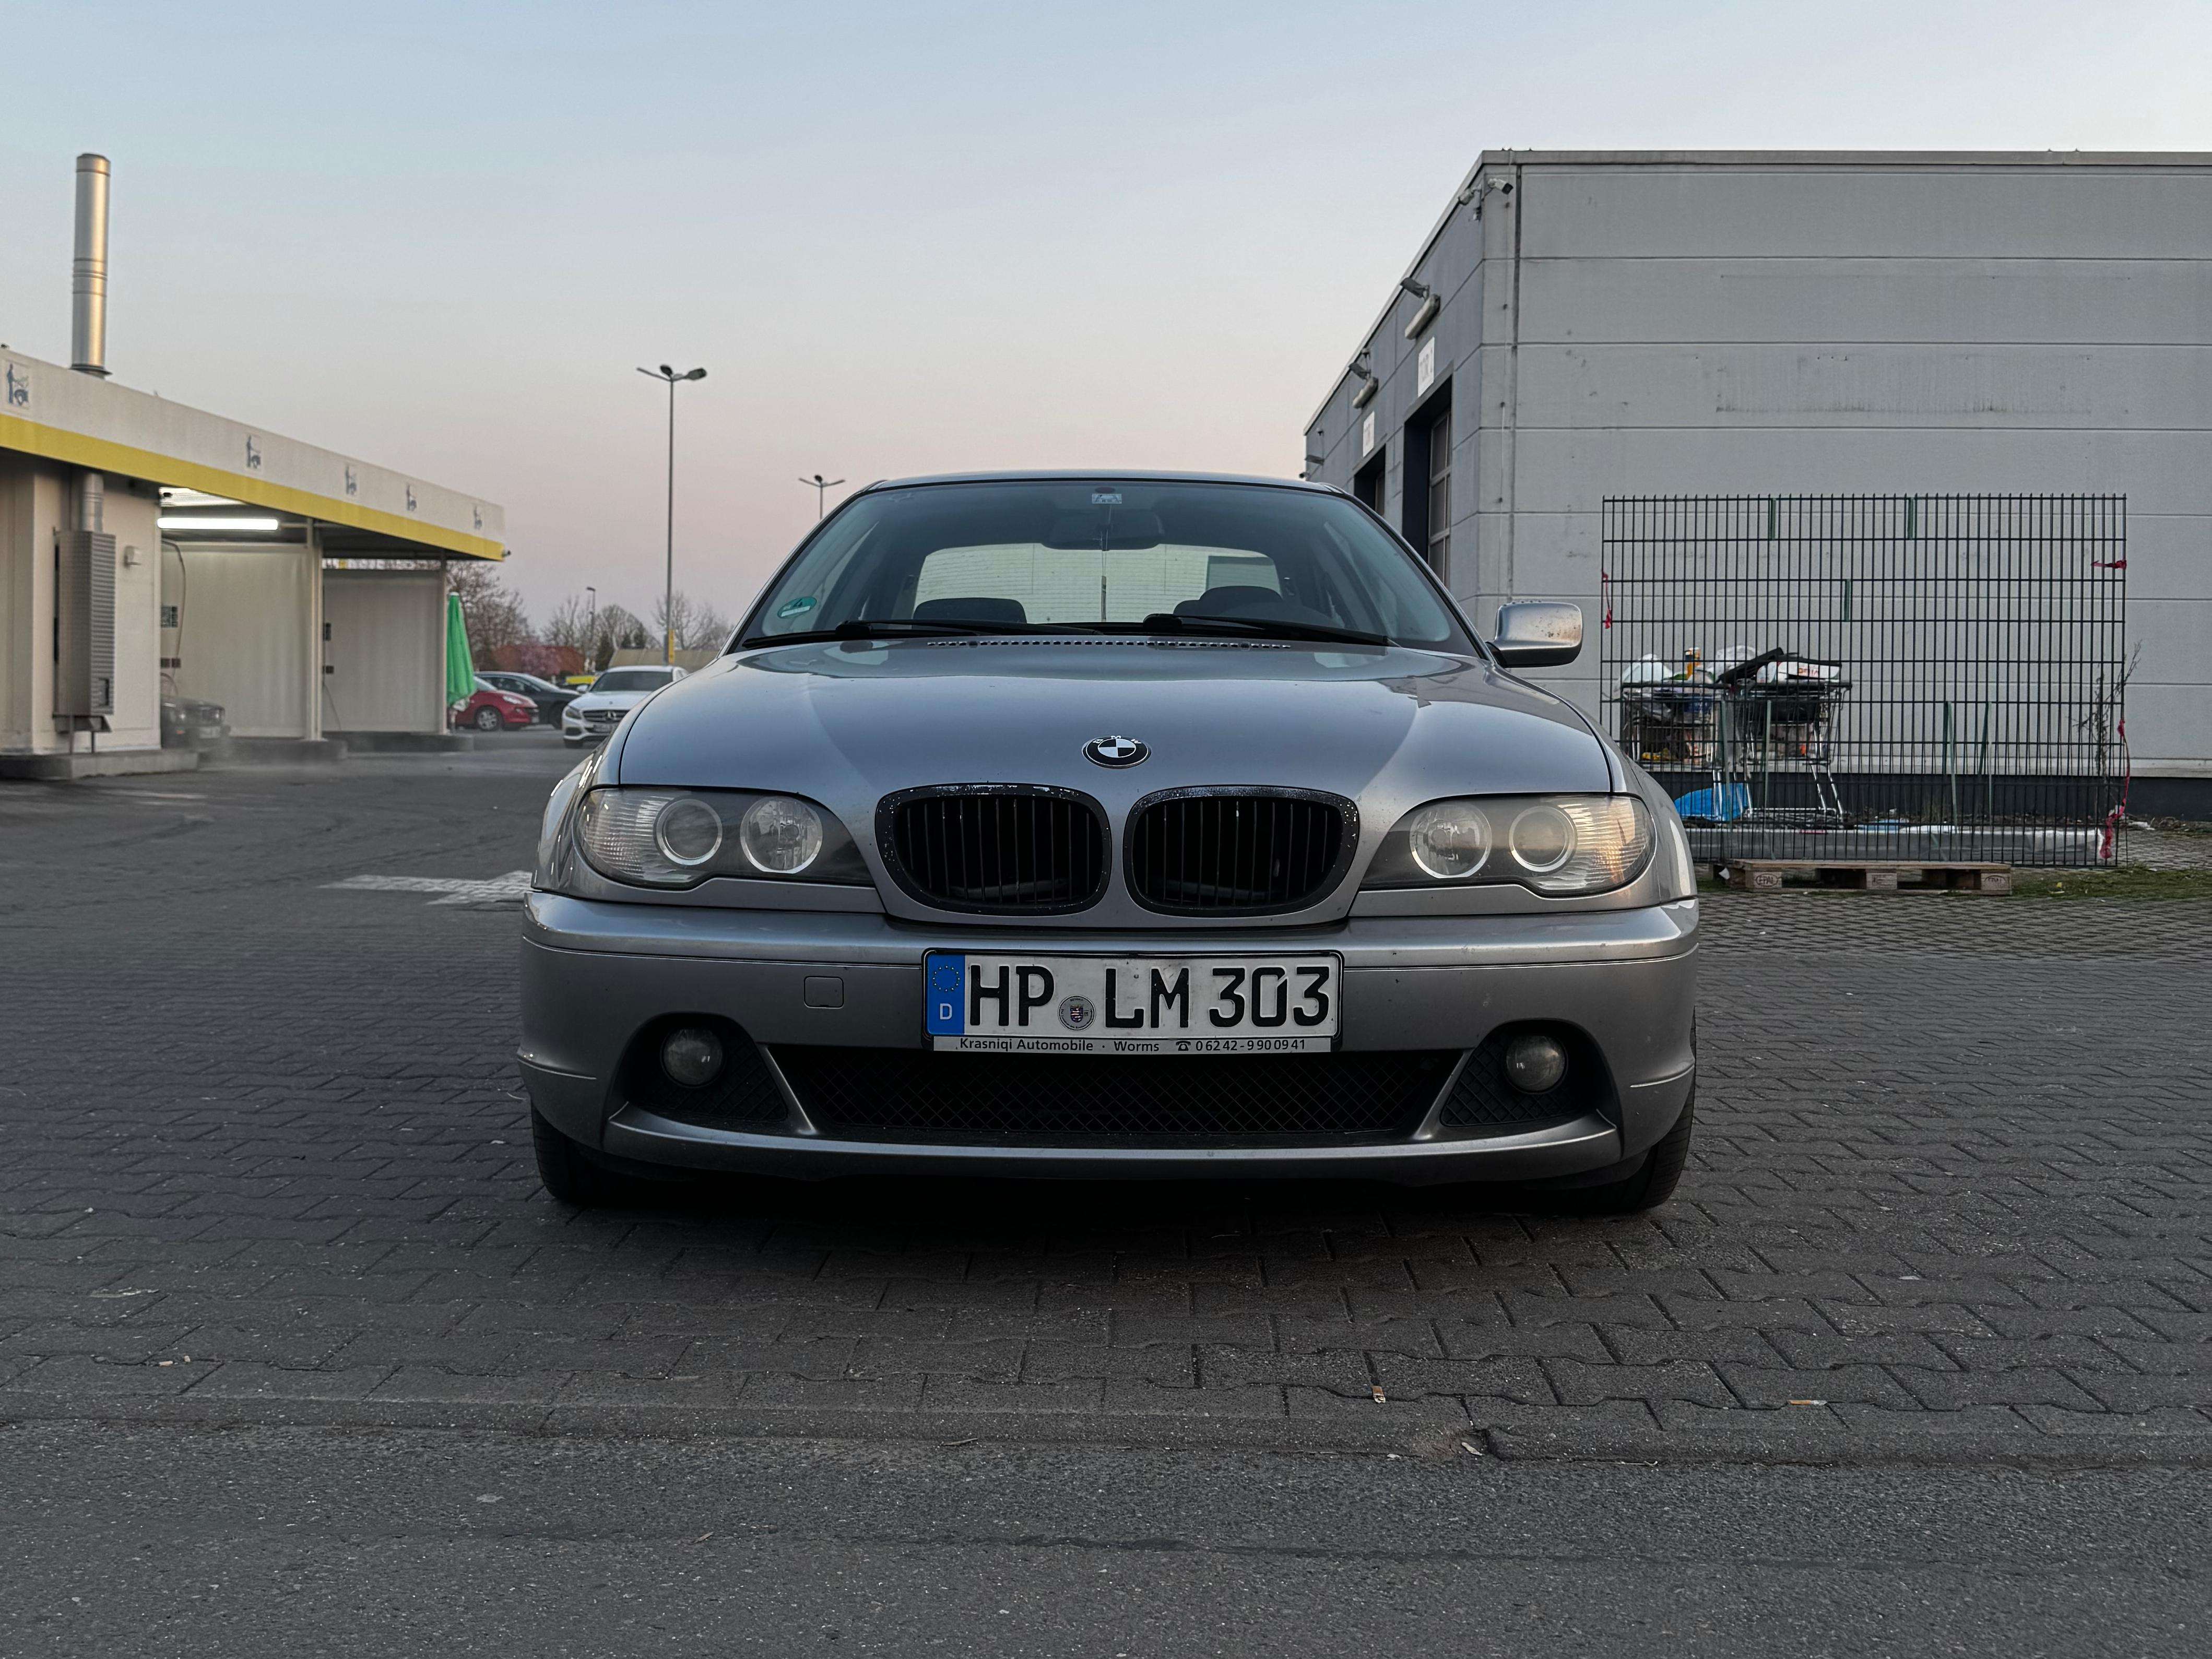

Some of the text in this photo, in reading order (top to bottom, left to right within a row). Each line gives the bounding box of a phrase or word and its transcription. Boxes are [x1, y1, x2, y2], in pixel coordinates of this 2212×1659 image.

[1092, 735, 1142, 744] BMW
[969, 965, 1055, 1026] HP
[1105, 967, 1189, 1028] LM
[1209, 966, 1330, 1028] 303
[940, 1003, 953, 1020] D
[960, 1037, 1013, 1052] Krasniqi
[1016, 1038, 1094, 1052] Automobile
[1113, 1040, 1160, 1052] Worms
